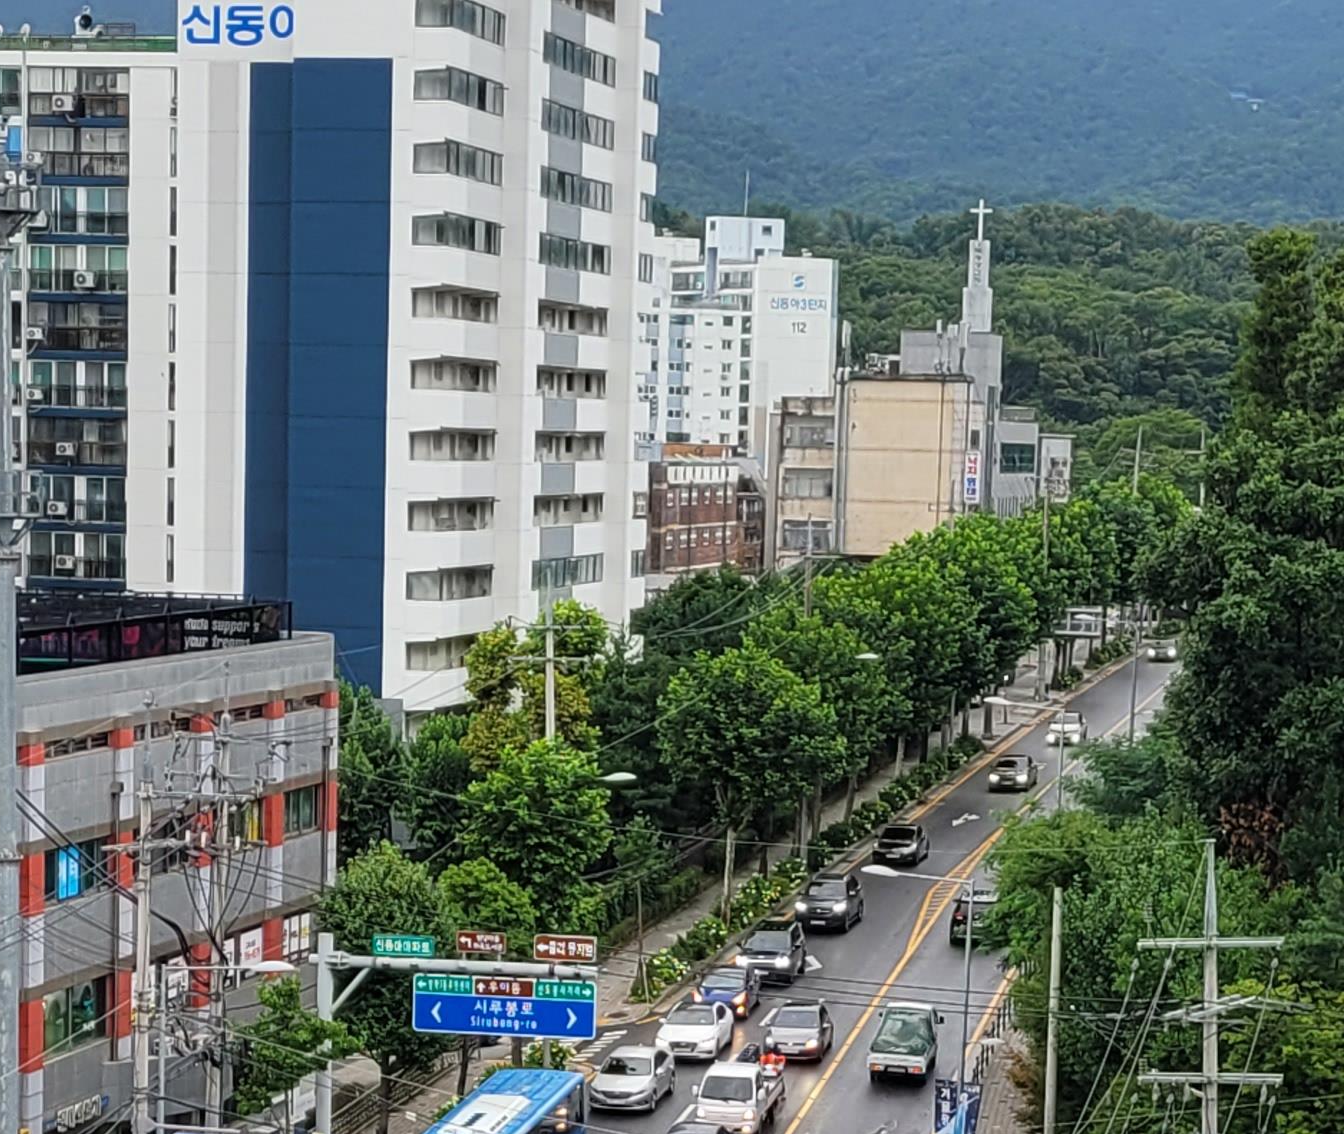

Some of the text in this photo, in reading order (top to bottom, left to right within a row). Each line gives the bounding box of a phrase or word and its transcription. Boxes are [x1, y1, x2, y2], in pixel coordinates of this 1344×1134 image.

[791, 322, 807, 334] 112
[211, 618, 260, 635] suppors
[488, 980, 521, 995] 우이동
[474, 998, 535, 1017] 시루봉로
